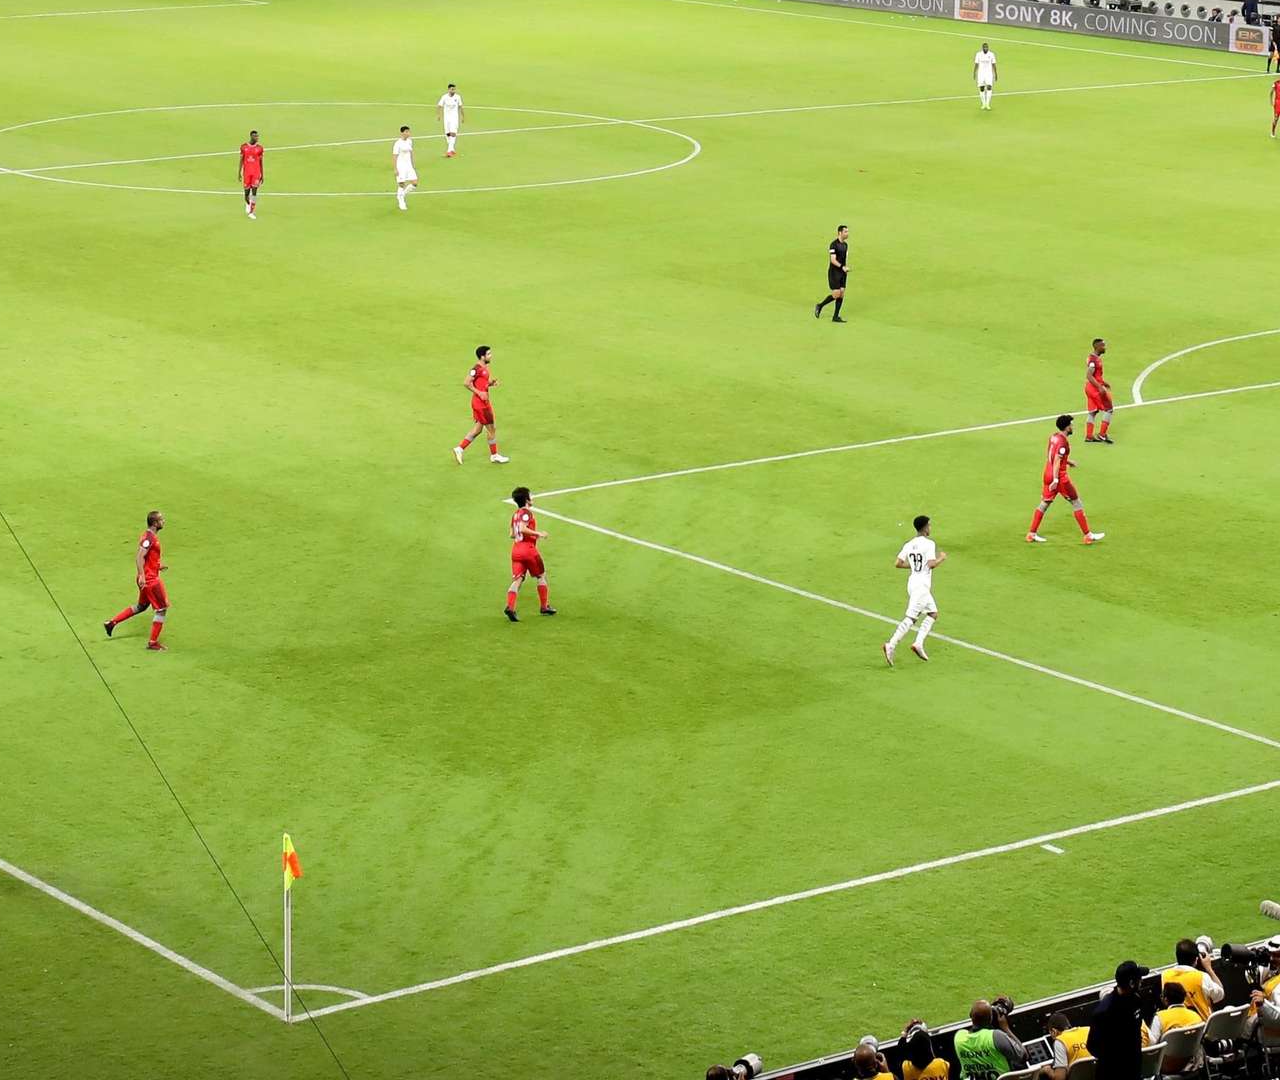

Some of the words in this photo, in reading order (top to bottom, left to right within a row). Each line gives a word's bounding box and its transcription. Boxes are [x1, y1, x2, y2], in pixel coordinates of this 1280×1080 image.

[994, 4, 1044, 24] SONY
[1050, 10, 1078, 28] 8K,
[1084, 12, 1157, 38] COMING
[1162, 20, 1222, 44] SOON.
